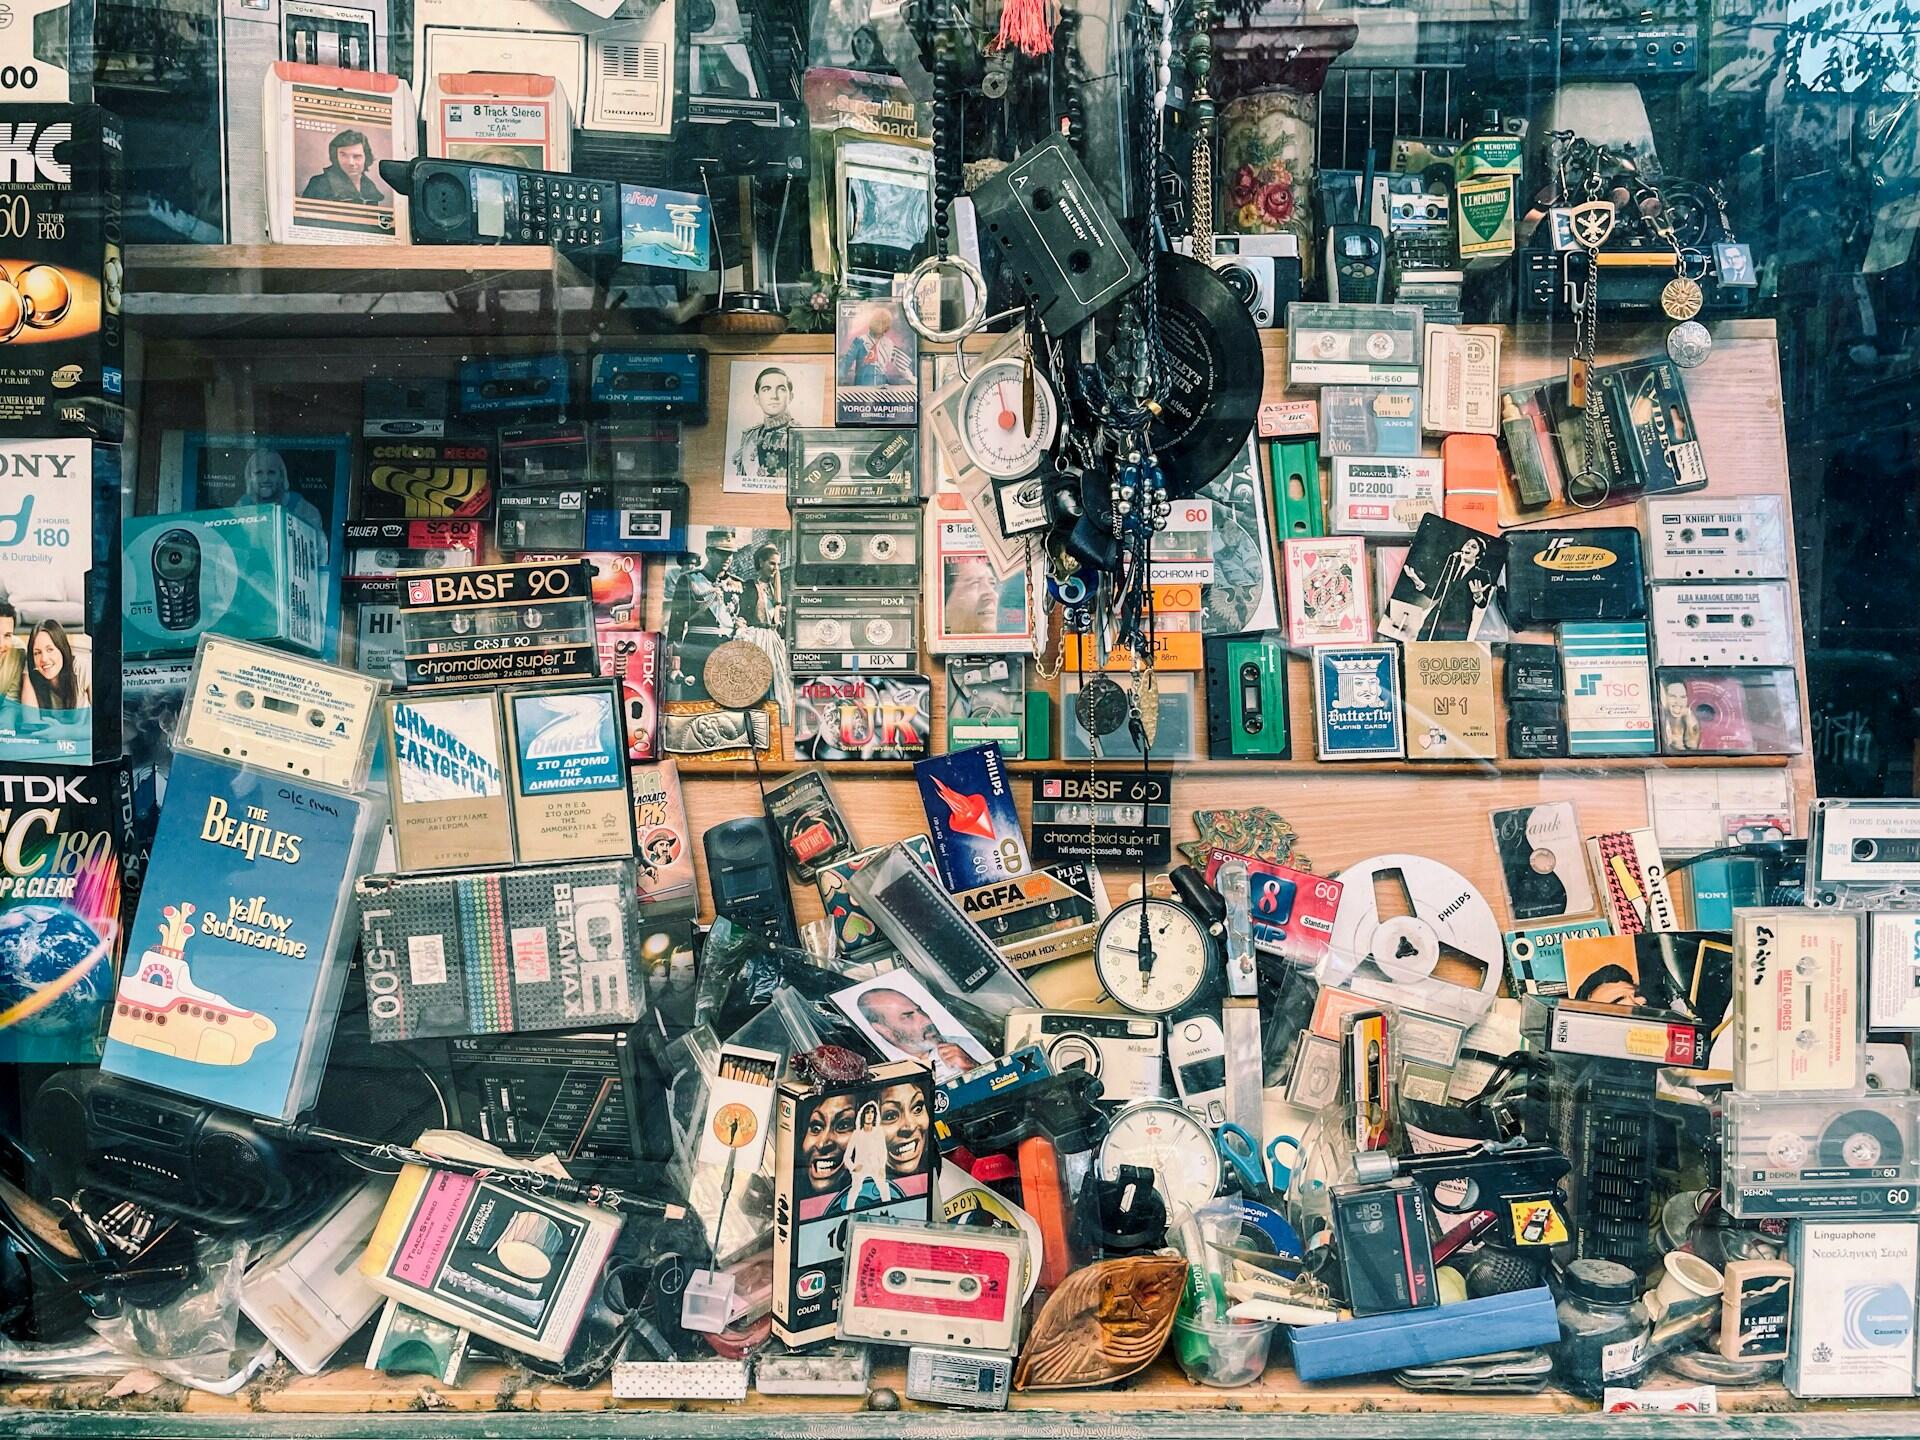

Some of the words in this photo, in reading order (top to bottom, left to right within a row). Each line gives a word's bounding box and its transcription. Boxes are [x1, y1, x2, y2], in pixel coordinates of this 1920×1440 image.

[474, 106, 482, 116] 8
[484, 106, 508, 117] Track
[512, 107, 541, 118] Stereo
[882, 101, 915, 121] Mini
[1015, 176, 1029, 189] A
[37, 213, 64, 223] SUPER
[1058, 198, 1088, 240] WELLTECH
[38, 223, 65, 240] PRO
[19, 369, 45, 377] SOUND
[5, 377, 31, 385] GRADE
[24, 396, 46, 406] GRADE
[1263, 403, 1310, 413] ASTOR
[62, 408, 86, 422] VHS
[842, 404, 872, 413] YORGO
[1260, 414, 1274, 434] 5
[1601, 413, 1615, 439] Head
[1608, 440, 1622, 475] Cleaner
[373, 444, 436, 459] certron
[807, 470, 822, 484] CD
[824, 486, 860, 496] CHROME
[502, 496, 532, 505] maxell
[203, 515, 269, 529] MOTOROLA
[1185, 509, 1208, 522] 60
[1685, 514, 1716, 523] KNIGHT
[1718, 514, 1742, 522] RIDER
[450, 522, 472, 535] 60
[947, 524, 954, 532] 8
[956, 524, 976, 533] Track
[1011, 520, 1024, 528] Tape
[33, 528, 70, 548] 180
[347, 526, 379, 537] SILVER
[1292, 545, 1301, 558] K
[1541, 537, 1575, 562] IF
[1560, 553, 1573, 561] YOU
[1574, 553, 1589, 561] SAY
[1591, 552, 1605, 561] YES
[11, 552, 53, 564] Durability
[609, 556, 635, 574] 60
[1196, 568, 1209, 578] HD
[435, 572, 515, 603] BASF
[528, 569, 570, 596] 90
[1162, 590, 1193, 607] 60
[1677, 593, 1694, 601] ALBA
[1695, 593, 1724, 601] KARAOKE
[1726, 593, 1744, 601] DEMO
[1745, 593, 1760, 602] TAPE
[130, 605, 153, 616] C115
[439, 641, 468, 654] BASF
[514, 636, 531, 648] 90
[793, 653, 821, 661] DENON
[1418, 657, 1481, 671] GOLDEN
[417, 654, 513, 677] chromdioxid
[515, 652, 561, 670] super
[643, 648, 655, 687] TDK
[446, 673, 467, 681] stereo
[468, 671, 498, 680] cassette
[1420, 672, 1480, 685] TROPHY
[801, 683, 866, 699] maxell
[1602, 683, 1640, 697] TSIC
[1327, 708, 1392, 725] Butterfly
[335, 722, 346, 732] A
[839, 704, 921, 746] UR
[1334, 723, 1361, 731] PLAYING
[1363, 723, 1387, 731] CARDS
[1625, 720, 1650, 730] C-90
[393, 702, 502, 782] ΔΗΜΟΚΡΑΤΙΑ
[632, 727, 651, 753] 60
[394, 732, 488, 799] ΕΛΕΥΘΕΡΙΑ
[536, 758, 561, 772] ΣΤΟ
[564, 755, 610, 768] ΔΡΟΜΟ
[559, 767, 582, 777] ΤΗΣ
[982, 750, 1005, 797] PHILIPS
[528, 774, 619, 791] ΔΗΜΟΚΡΑΤΙΑΣ
[0, 775, 89, 805] TDK
[1064, 780, 1124, 799] BASF
[1130, 781, 1162, 801] 60
[636, 791, 667, 804] ΛΟΧΑΓΟ
[119, 791, 135, 842] TDK
[246, 804, 269, 822] THE
[545, 810, 561, 818] ΣΤΟ
[563, 808, 592, 816] ΔΡΟΜΟ
[200, 795, 303, 864] BEATLES
[541, 823, 597, 834] ΔΗΜΟΚΡΑΤΙΑΣ
[51, 830, 112, 876] 180
[999, 838, 1019, 874] CD
[1068, 847, 1091, 855] stereo
[1092, 847, 1122, 856] cassette
[1125, 848, 1144, 856] 88m
[973, 855, 989, 875] 60
[992, 849, 1003, 870] one
[1057, 864, 1084, 880] PLUS
[963, 883, 1026, 913] AGFA
[1314, 882, 1340, 902] 60
[1645, 865, 1672, 930] Carina
[1697, 892, 1728, 900] SONY
[1438, 891, 1472, 923] PHILIPS
[229, 896, 293, 934] Yellow
[1303, 917, 1330, 931] Standard
[201, 911, 307, 960] Submarine
[1535, 927, 1601, 949] BOYAKAN
[553, 882, 584, 1017] BETAMAX
[1038, 944, 1057, 955] HDX
[362, 909, 402, 1020] L-500
[1783, 970, 1793, 998] METAL
[1782, 998, 1792, 1031] FORCES
[453, 1039, 478, 1049] TEC
[1674, 1032, 1690, 1058] HS
[1186, 1047, 1211, 1057] SIEMENS
[1019, 1053, 1042, 1075] X
[995, 1071, 1018, 1085] Cubes
[109, 1155, 128, 1164] TWIN
[132, 1159, 173, 1178] SPEAKERS
[1883, 1169, 1896, 1178] 60
[1743, 1189, 1771, 1197] DENON
[1860, 1191, 1881, 1205] DX
[1886, 1188, 1910, 1205] 60
[1415, 1194, 1424, 1222] SONY
[408, 1230, 424, 1261] TRACK
[418, 1200, 438, 1232] STEREO
[1814, 1231, 1877, 1242] Linguaphone
[1811, 1248, 1878, 1260] Νεοελληνική
[1881, 1247, 1908, 1260] Σειρά
[989, 1280, 999, 1292] 2
[797, 1303, 820, 1316] COLOR
[1758, 1316, 1784, 1325] MILITARY
[1751, 1324, 1777, 1333] SURPLUS
[1873, 1328, 1903, 1336] Cassette
